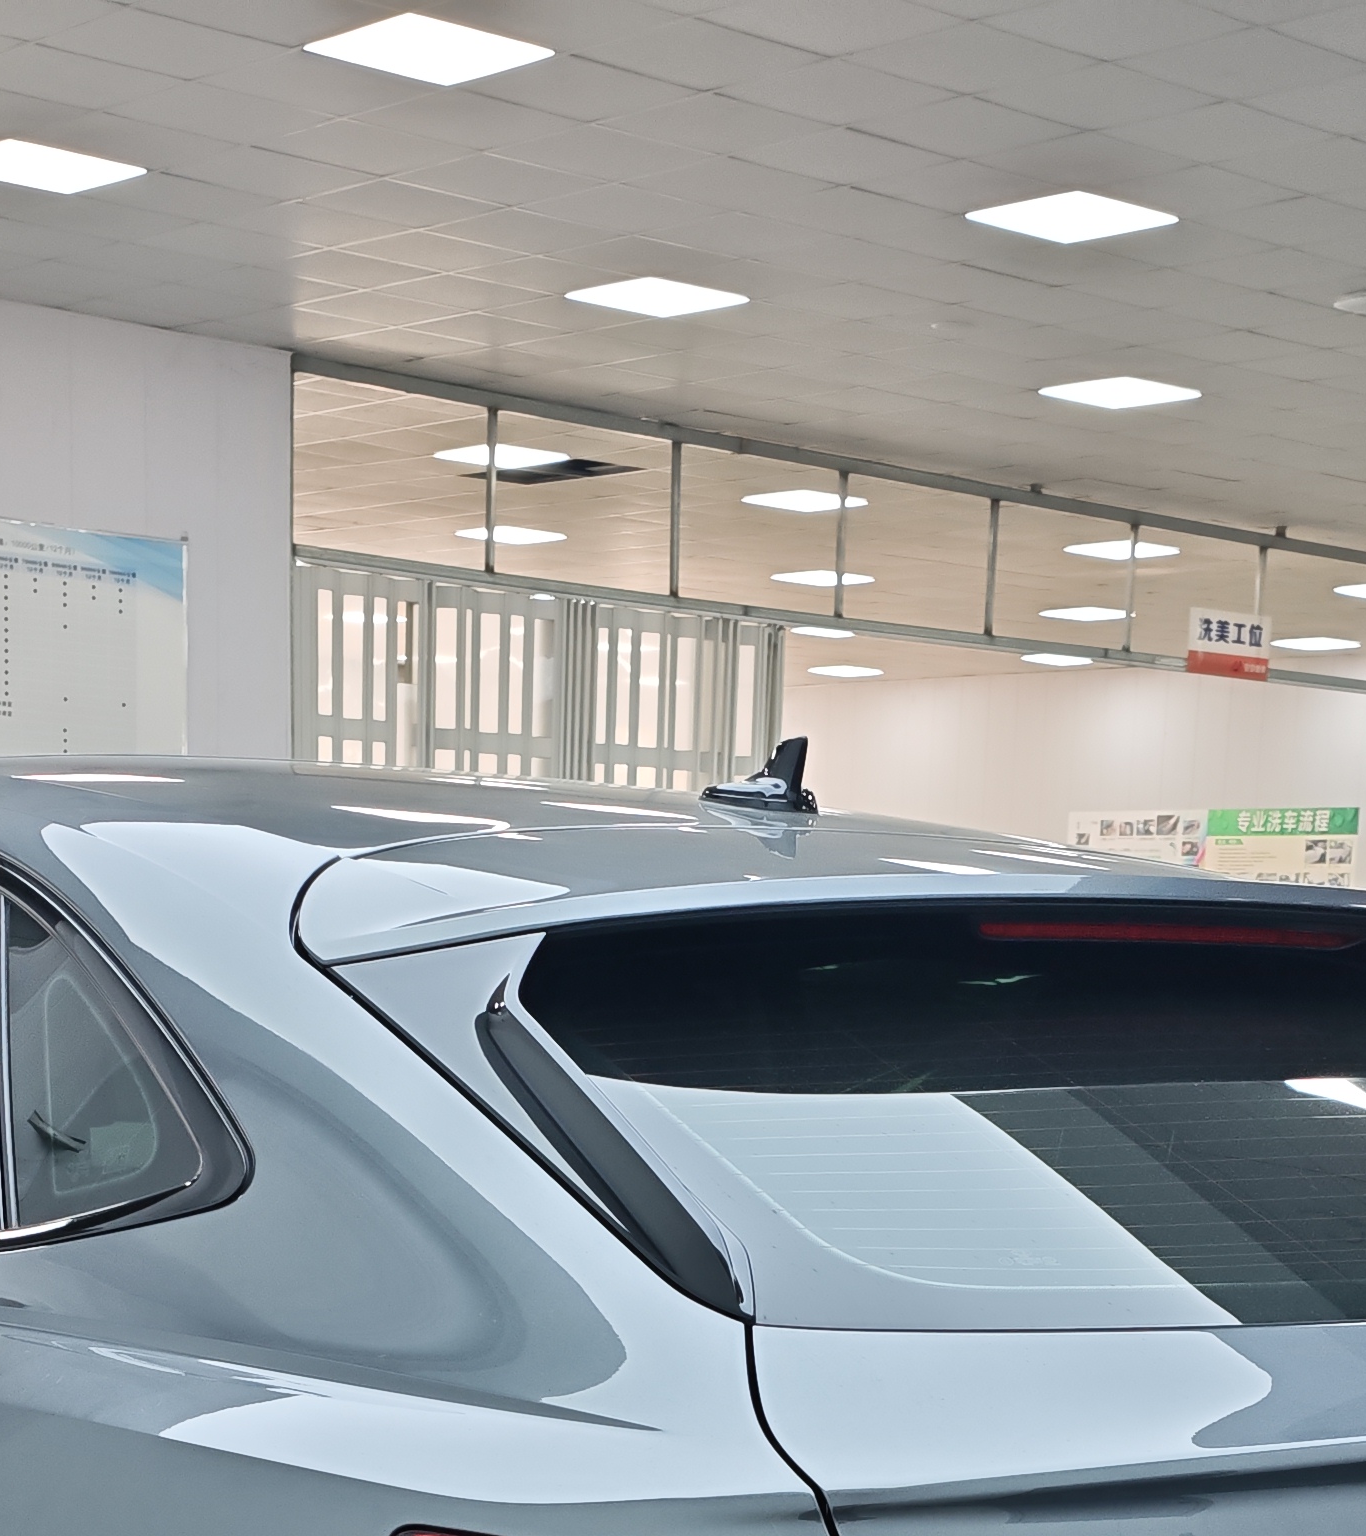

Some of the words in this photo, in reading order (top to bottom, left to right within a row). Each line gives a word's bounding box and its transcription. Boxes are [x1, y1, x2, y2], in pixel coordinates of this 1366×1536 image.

[1197, 617, 1263, 648] 洗美工位
[1237, 810, 1330, 832] 专业洗车流程
